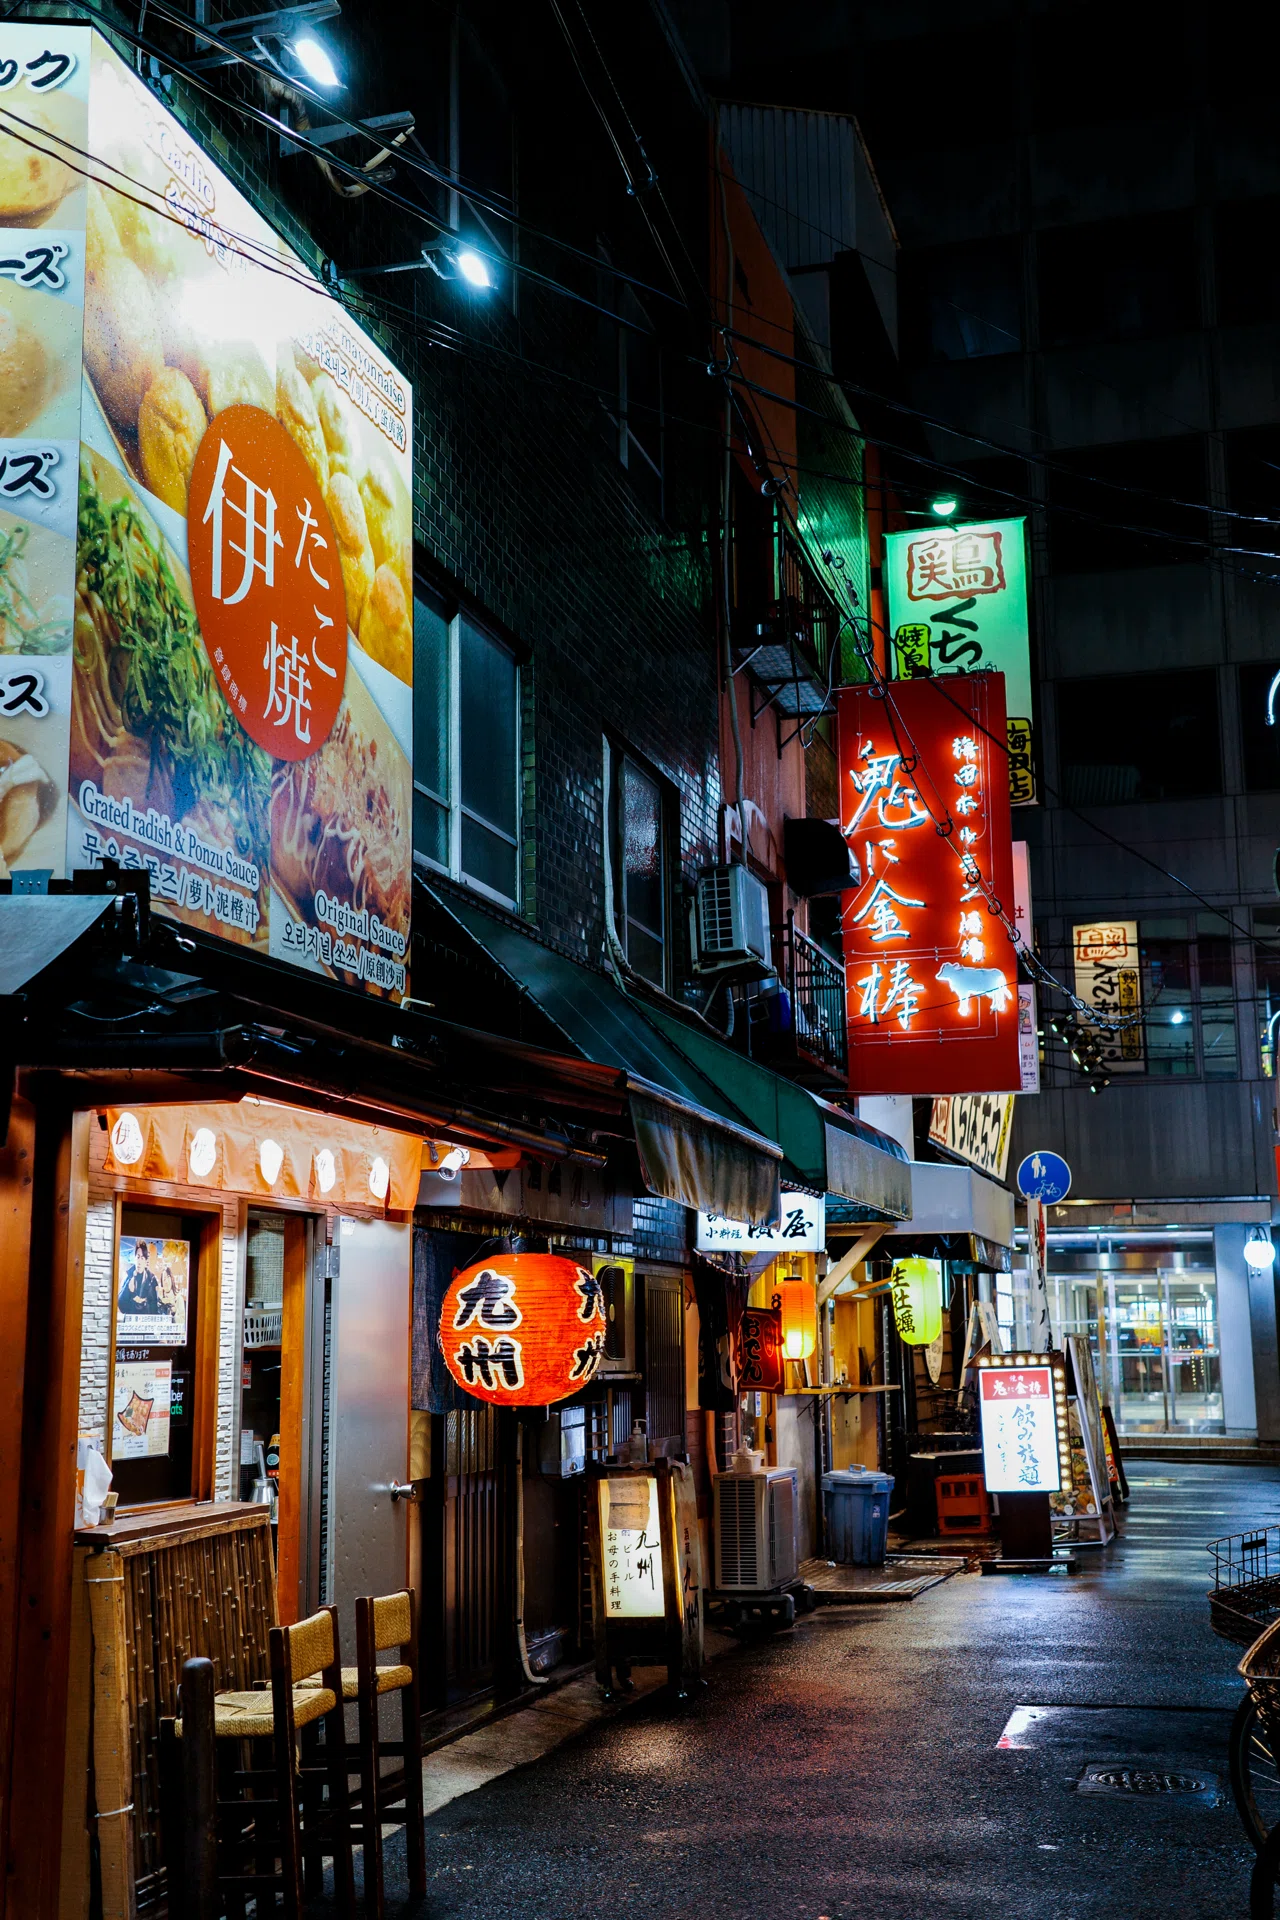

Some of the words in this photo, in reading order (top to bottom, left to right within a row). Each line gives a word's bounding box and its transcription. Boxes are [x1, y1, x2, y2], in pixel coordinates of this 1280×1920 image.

[0, 453, 55, 493] ズ
[203, 438, 283, 605] 伊
[917, 536, 993, 592] 鶏
[0, 674, 43, 711] ス
[83, 786, 130, 830] Grated
[132, 814, 172, 850] radish
[174, 828, 185, 855] &
[188, 833, 223, 872] Ponzu
[225, 851, 257, 887] Sauce
[843, 740, 930, 1030] 鬼に金棒
[282, 922, 330, 961] 오리지널
[317, 894, 368, 936] Original
[371, 919, 404, 952] Sauce
[456, 1272, 520, 1387] 九州
[743, 1317, 763, 1382] おでん
[170, 1391, 184, 1401] ber
[992, 1380, 1041, 1397] 鬼に金棒
[1011, 1404, 1042, 1486] 飲み放題
[607, 1531, 622, 1610] お母の手料理
[623, 1544, 635, 1582] ビール
[635, 1531, 660, 1590] 九州
